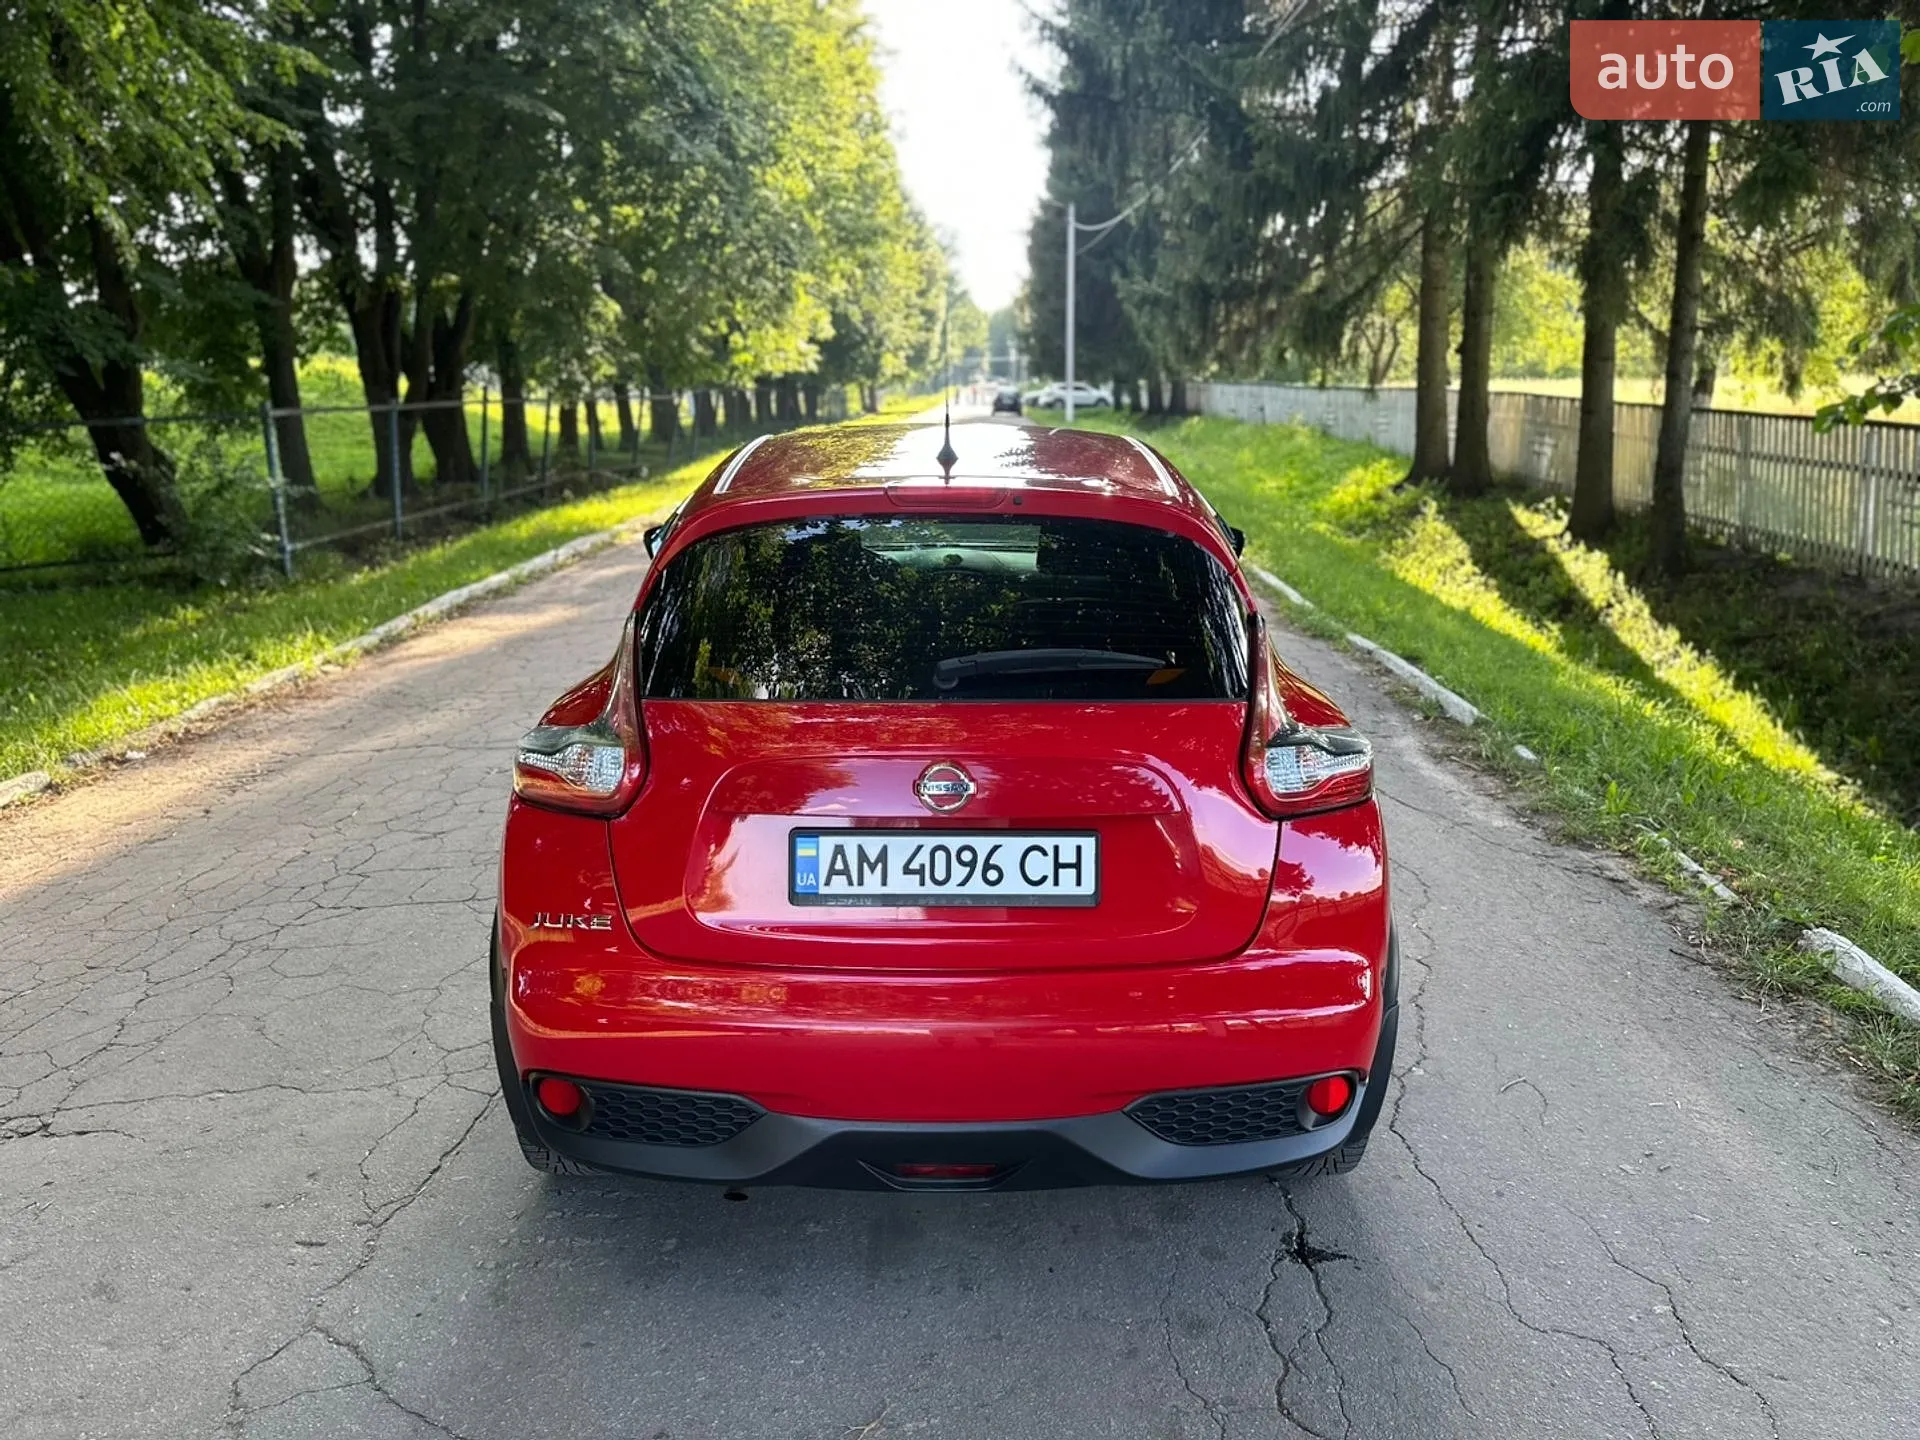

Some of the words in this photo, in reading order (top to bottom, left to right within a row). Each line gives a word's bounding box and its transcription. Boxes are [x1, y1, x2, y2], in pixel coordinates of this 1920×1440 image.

[922, 783, 969, 792] NISSAN
[823, 844, 888, 887] AM
[902, 844, 1005, 887] 4096
[1019, 844, 1083, 887] CH
[797, 873, 817, 886] UA
[528, 912, 612, 930] JUKE
